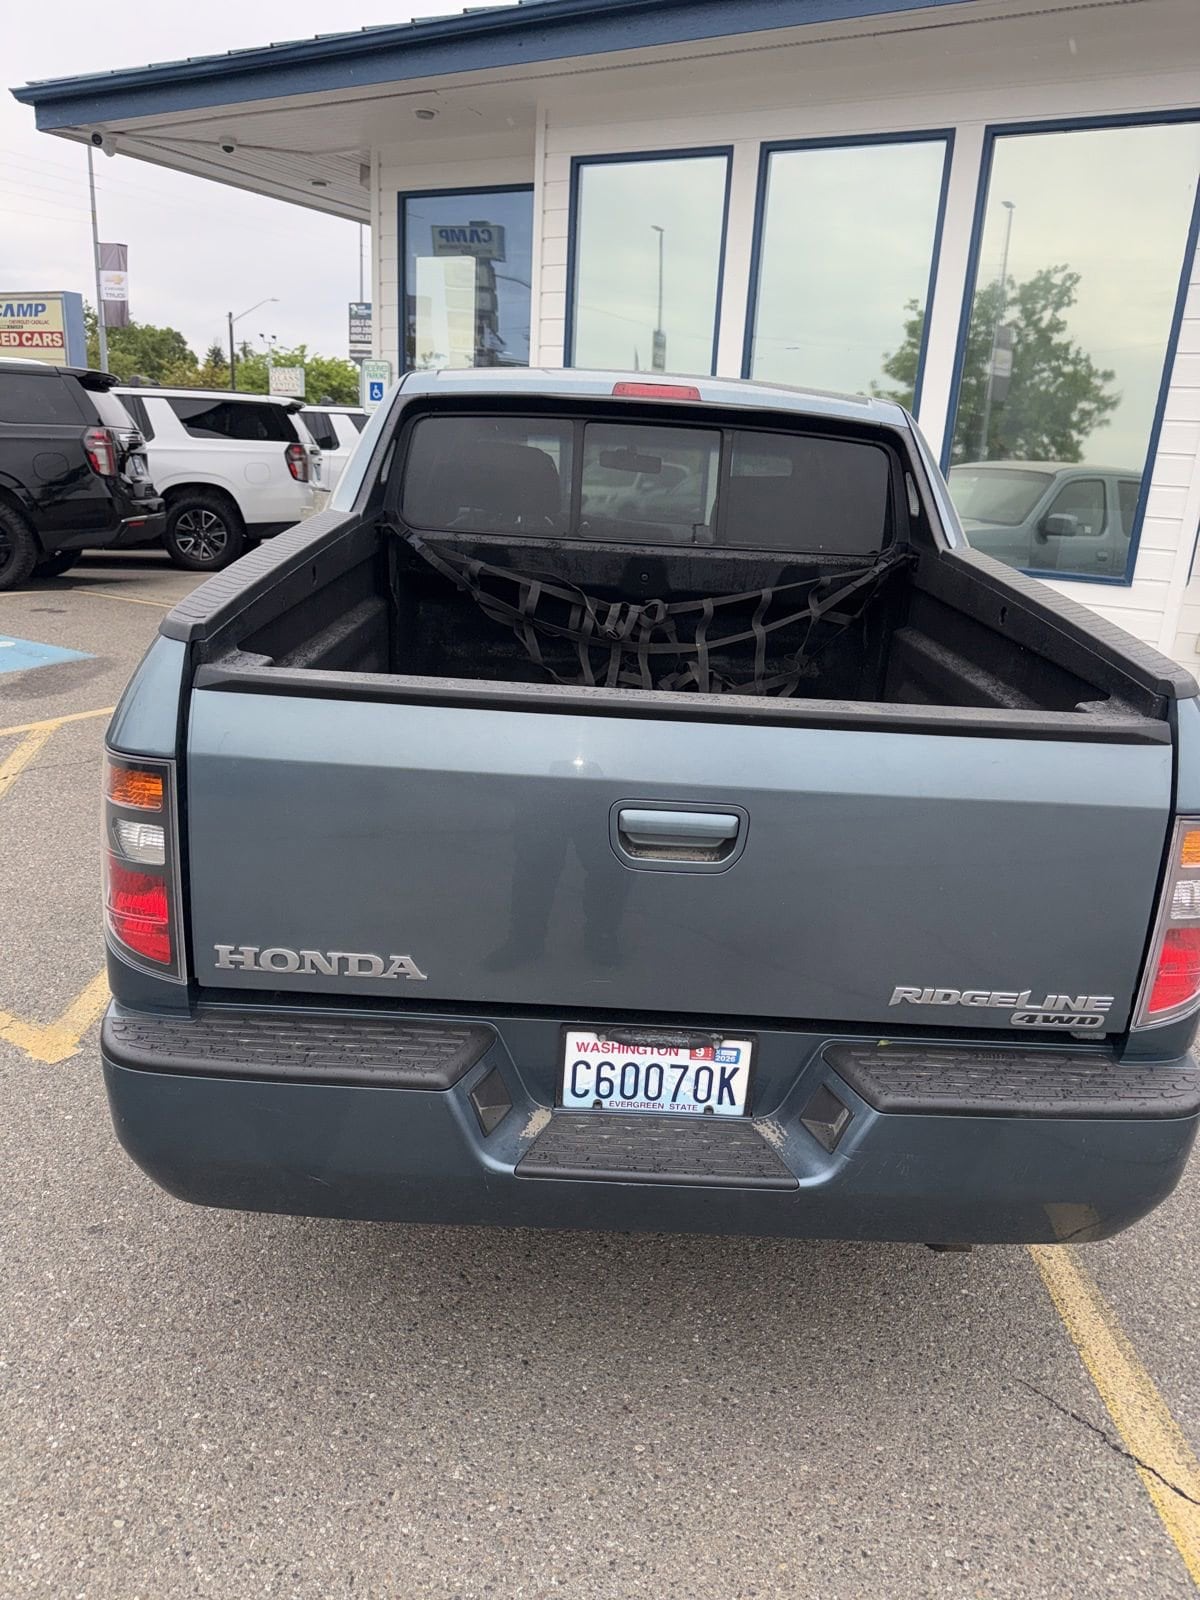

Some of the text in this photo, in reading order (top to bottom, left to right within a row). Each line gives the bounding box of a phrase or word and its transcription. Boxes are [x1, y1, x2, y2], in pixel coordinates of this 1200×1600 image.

[0, 303, 46, 317] AMP
[0, 333, 63, 347] ED CARS
[214, 944, 428, 980] HONDA
[888, 986, 1115, 1011] RIDGELINE
[1013, 1013, 1101, 1026] 4WD
[576, 1041, 679, 1057] WASHINGTON
[570, 1060, 740, 1106] C60070K
[608, 1100, 699, 1112] EVERGREEN STATE
